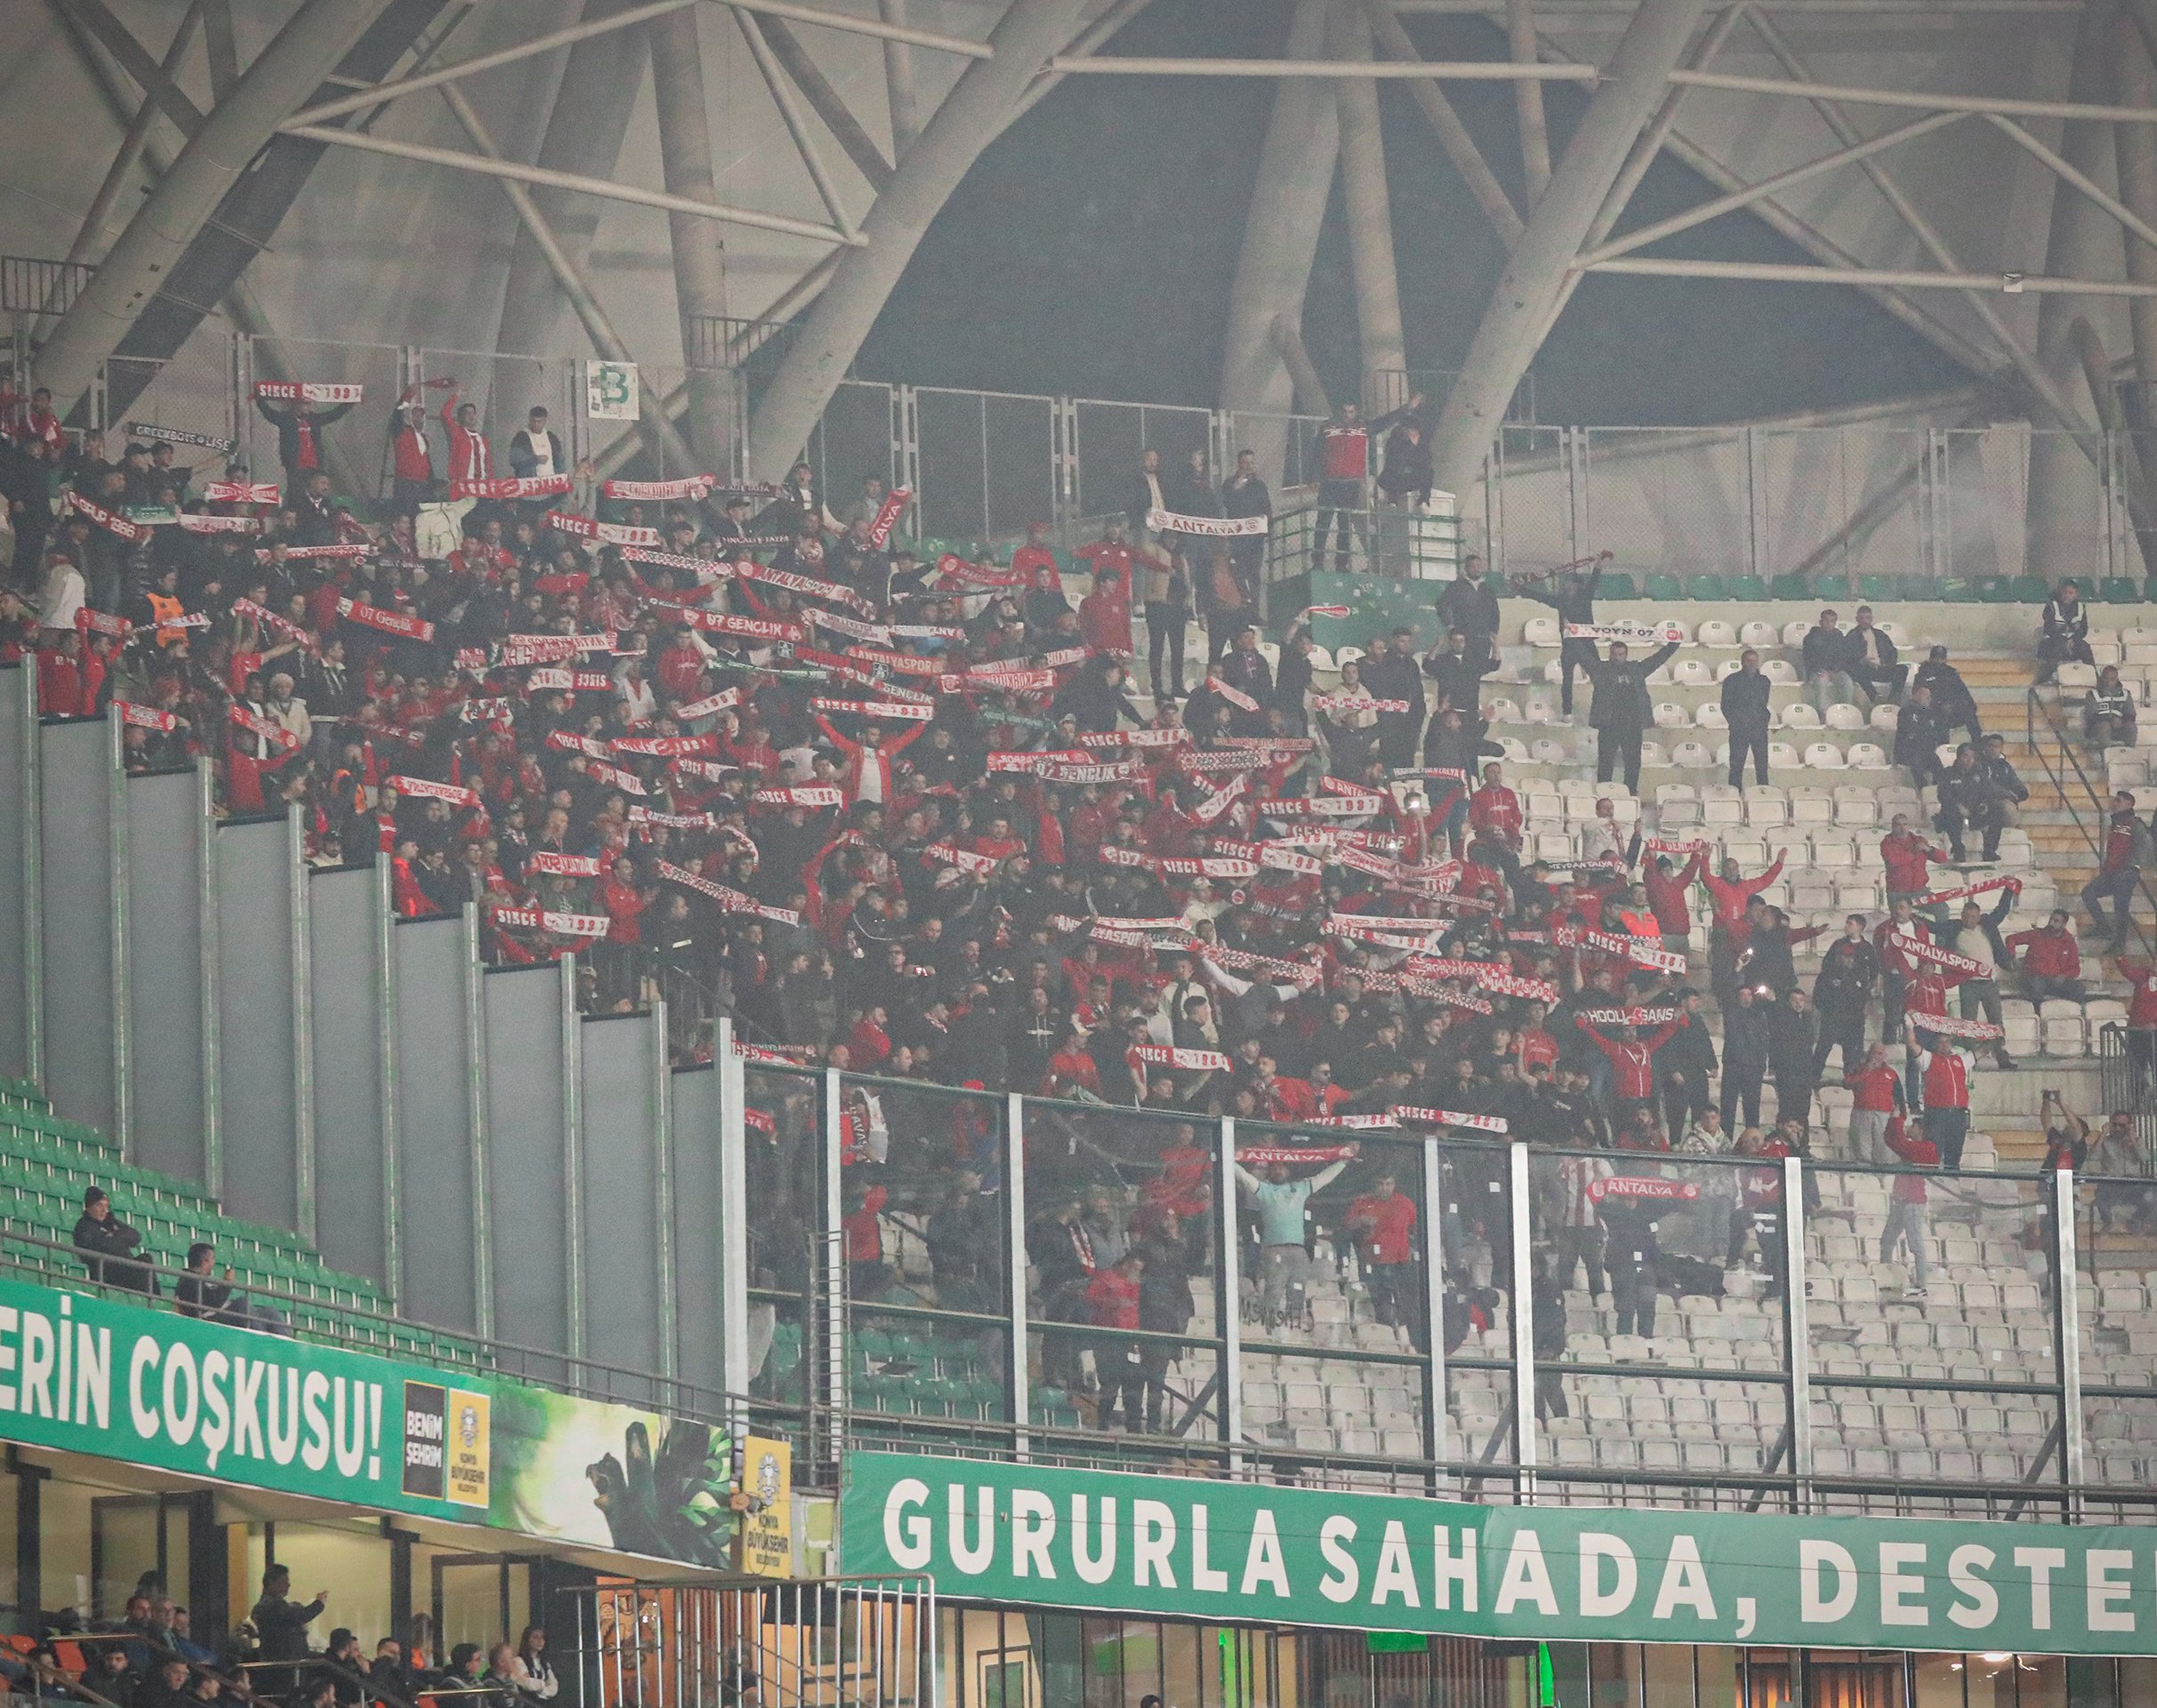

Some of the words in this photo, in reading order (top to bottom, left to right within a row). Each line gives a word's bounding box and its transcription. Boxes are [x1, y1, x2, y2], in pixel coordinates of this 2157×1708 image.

[259, 383, 296, 399] SINCE
[551, 515, 591, 535] SINCE
[1171, 518, 1235, 535] ANTALYA
[359, 606, 374, 621] 07
[817, 699, 858, 712] SINCE
[1081, 733, 1122, 747] SINCE
[1260, 801, 1303, 815] SINCE
[1214, 840, 1255, 859] SINCE
[1163, 859, 1199, 874] SINCE
[496, 908, 537, 926] SINCE
[1325, 921, 1366, 939] SINCE
[1588, 931, 1623, 955] SINCE
[1904, 937, 1977, 972] ANTALYASPOR
[1397, 1106, 1436, 1121] SINCE
[1607, 1180, 1673, 1196] ANTALYA
[129, 1334, 383, 1481] COŞKUSU!
[882, 1477, 1292, 1599] GURURLA
[1318, 1514, 1758, 1640] SAHADA,
[1799, 1538, 2157, 1632] DESTE
